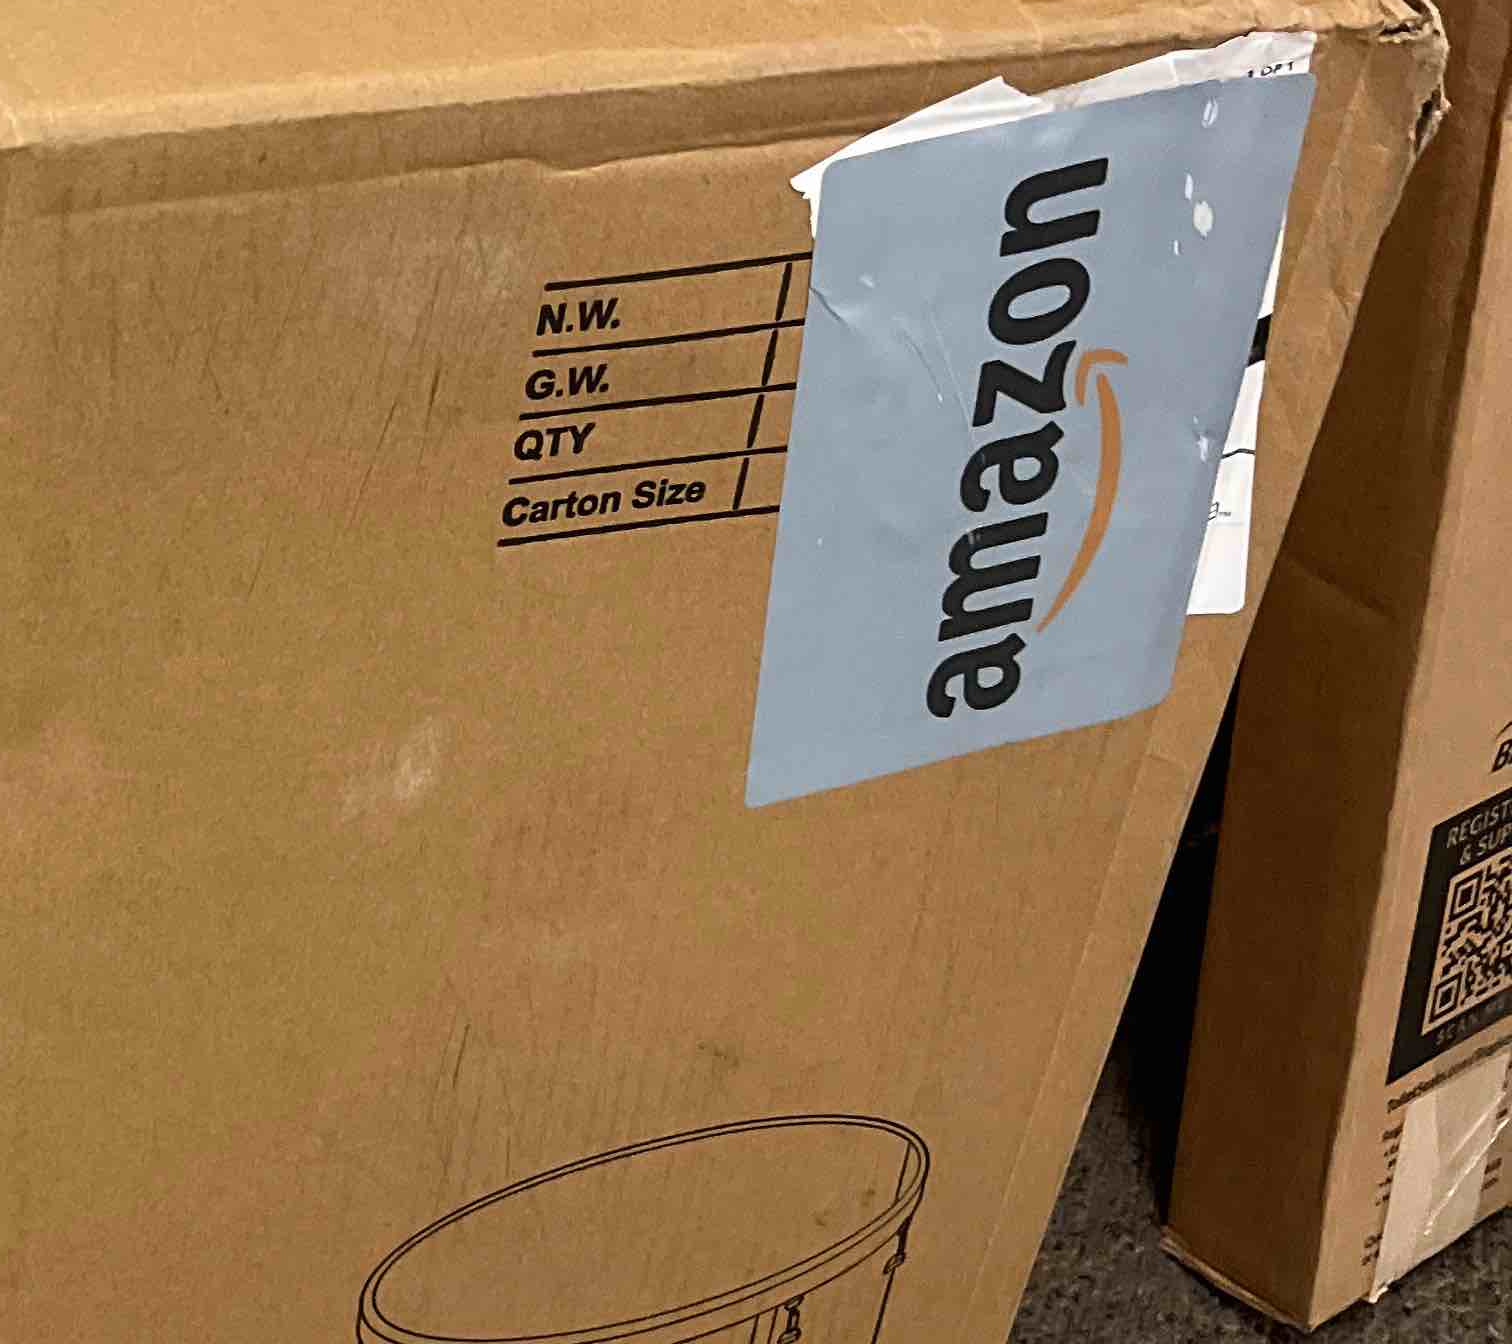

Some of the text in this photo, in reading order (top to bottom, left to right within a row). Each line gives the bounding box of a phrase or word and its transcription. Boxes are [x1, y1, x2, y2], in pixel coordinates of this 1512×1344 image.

[535, 297, 621, 337] N.W.
[525, 363, 610, 401] G.W.
[513, 422, 596, 461] QTY
[926, 157, 1109, 719] amazon
[502, 478, 707, 528] Carton Size
[1446, 799, 1512, 848] REGIST
